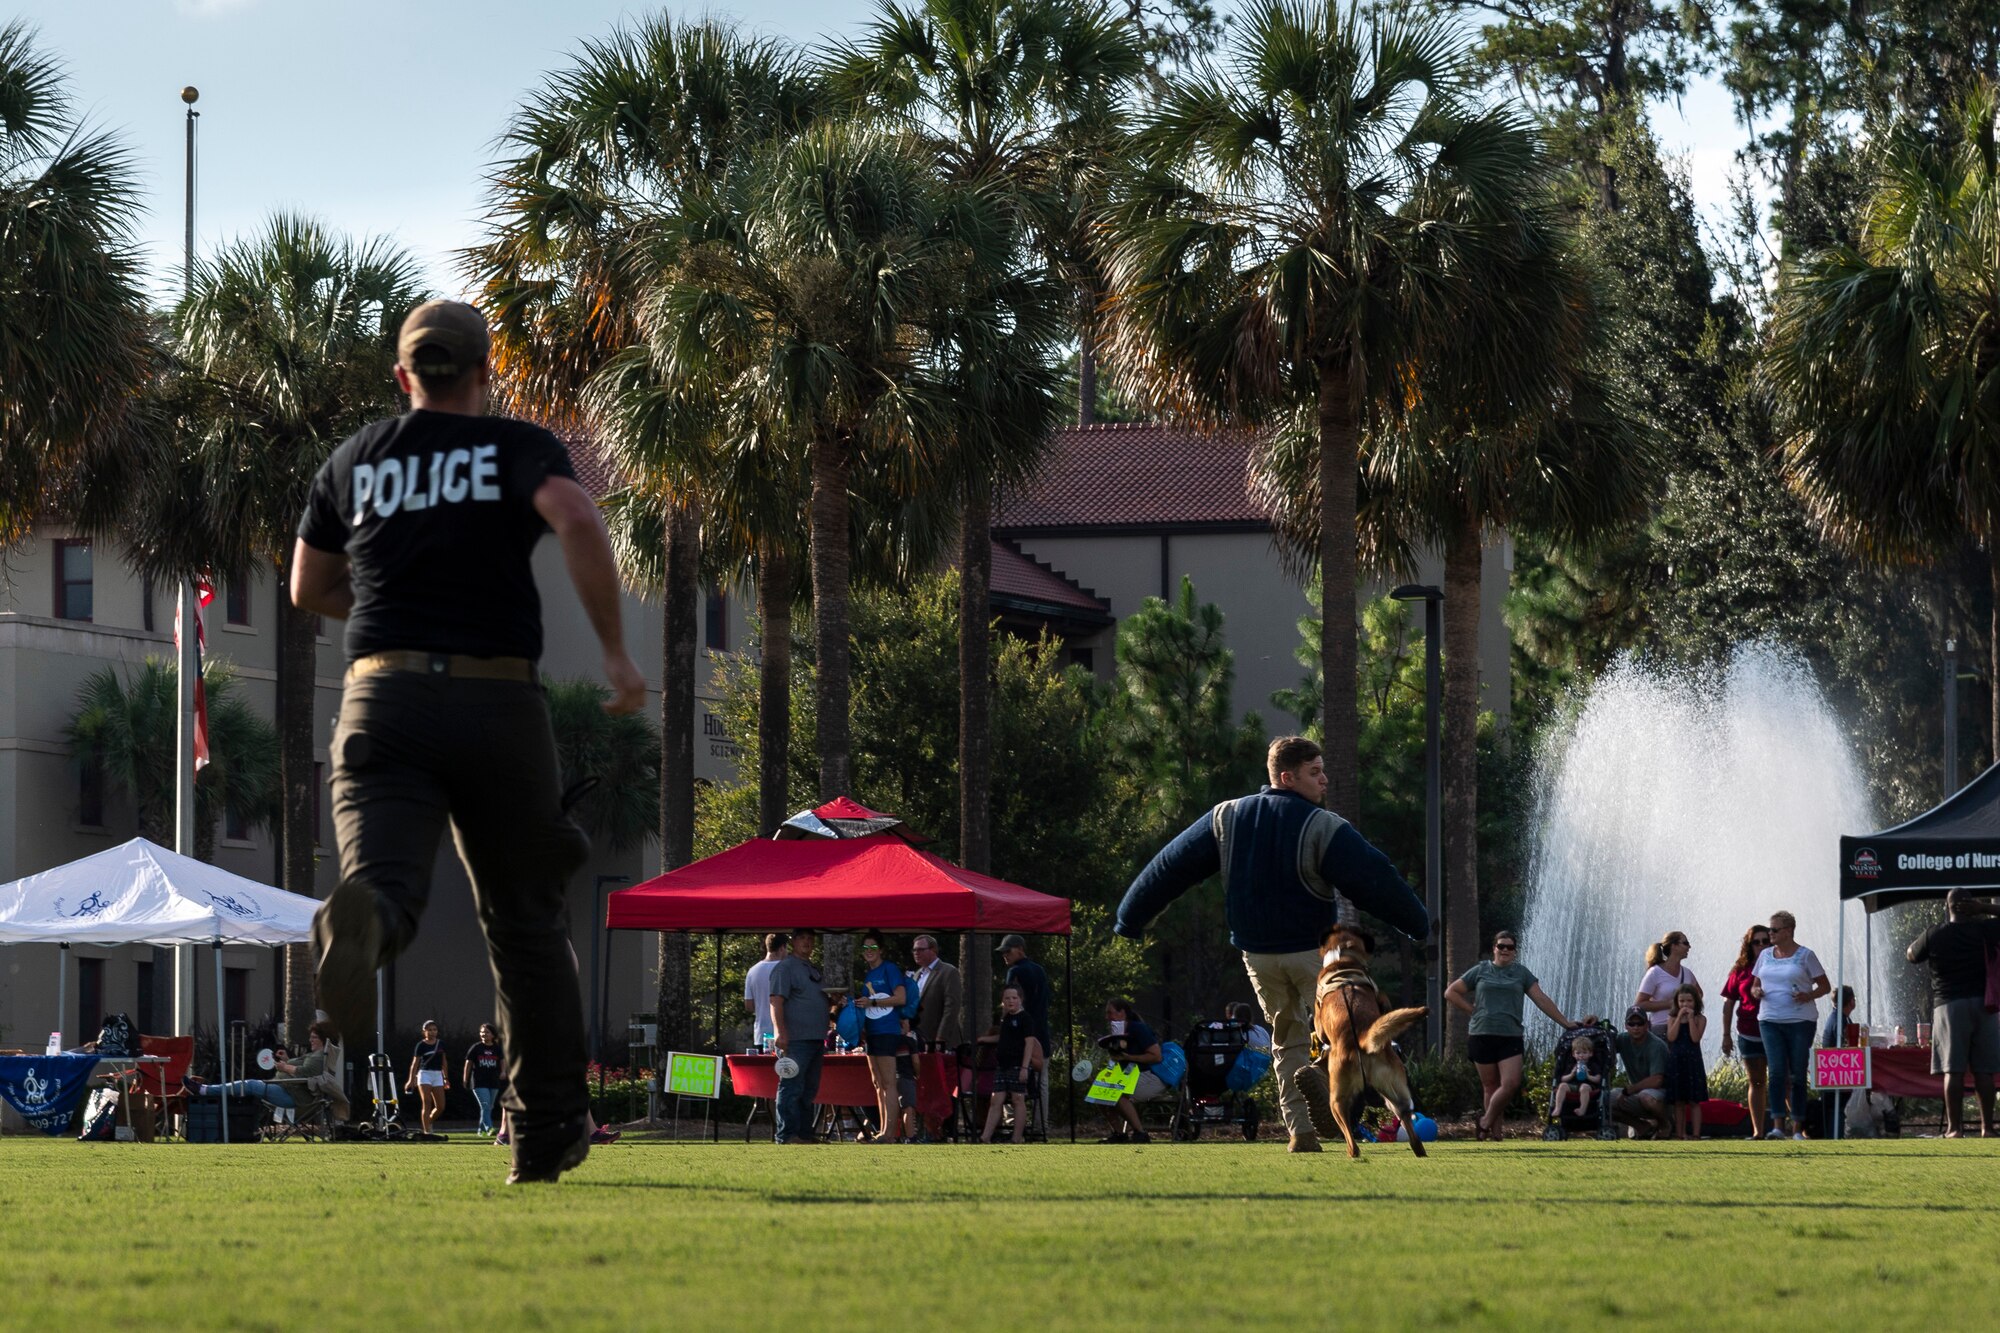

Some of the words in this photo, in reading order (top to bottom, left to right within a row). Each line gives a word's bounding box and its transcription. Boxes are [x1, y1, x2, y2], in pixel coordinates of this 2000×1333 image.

[352, 444, 501, 526] POLICE
[703, 713, 728, 736] HUG
[1898, 853, 1953, 871] College
[1955, 853, 1970, 869] of
[675, 1057, 714, 1076] FACE
[1817, 1053, 1861, 1068] ROCK
[671, 1076, 713, 1095] PAINT
[1818, 1070, 1864, 1086] PAINT
